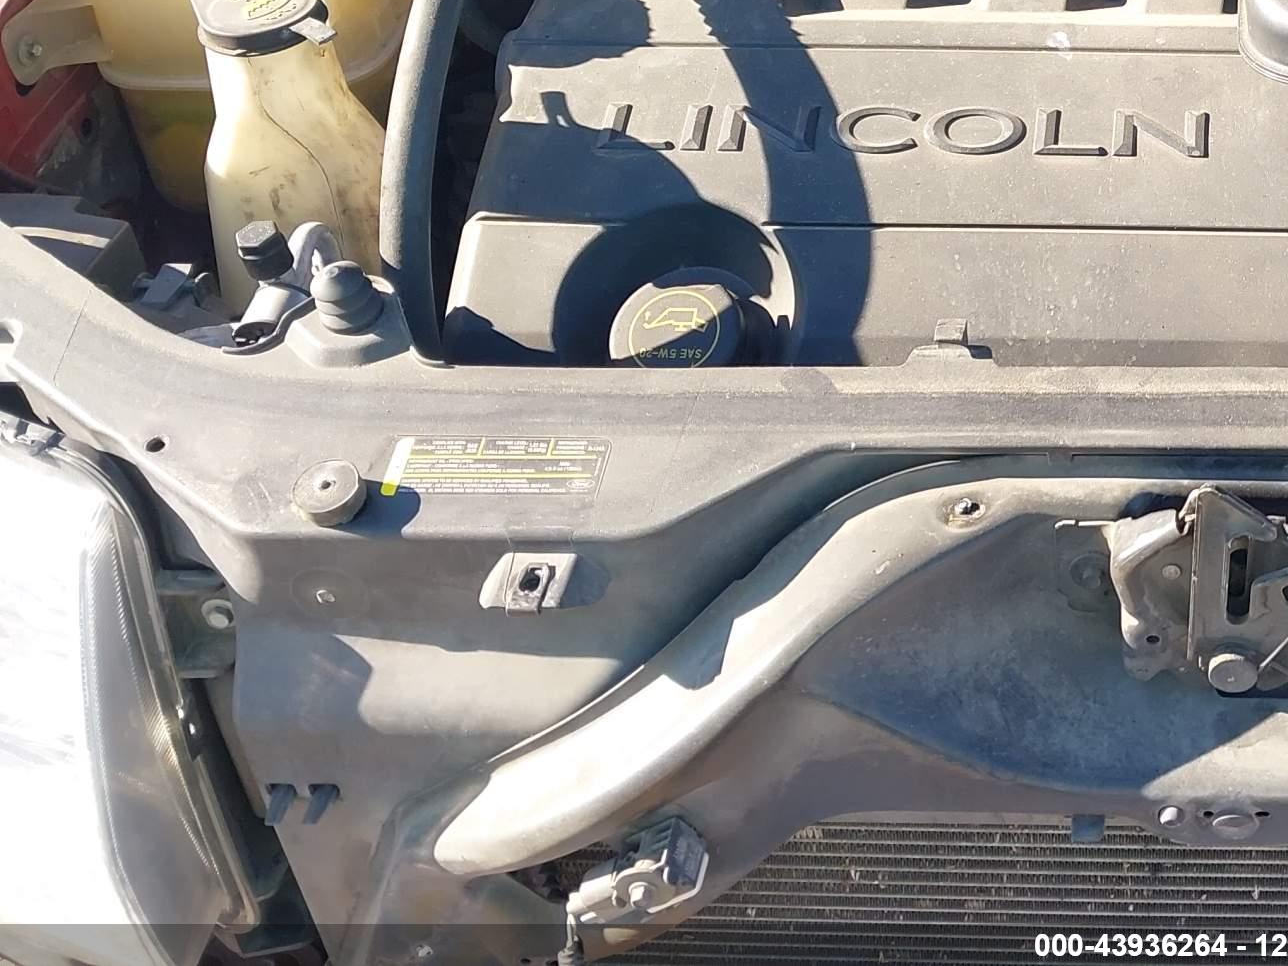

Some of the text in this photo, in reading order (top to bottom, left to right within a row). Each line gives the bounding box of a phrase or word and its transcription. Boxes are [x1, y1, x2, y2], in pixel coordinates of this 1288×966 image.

[594, 102, 1211, 159] LINCOLN
[639, 347, 703, 359] SAE 5W-20
